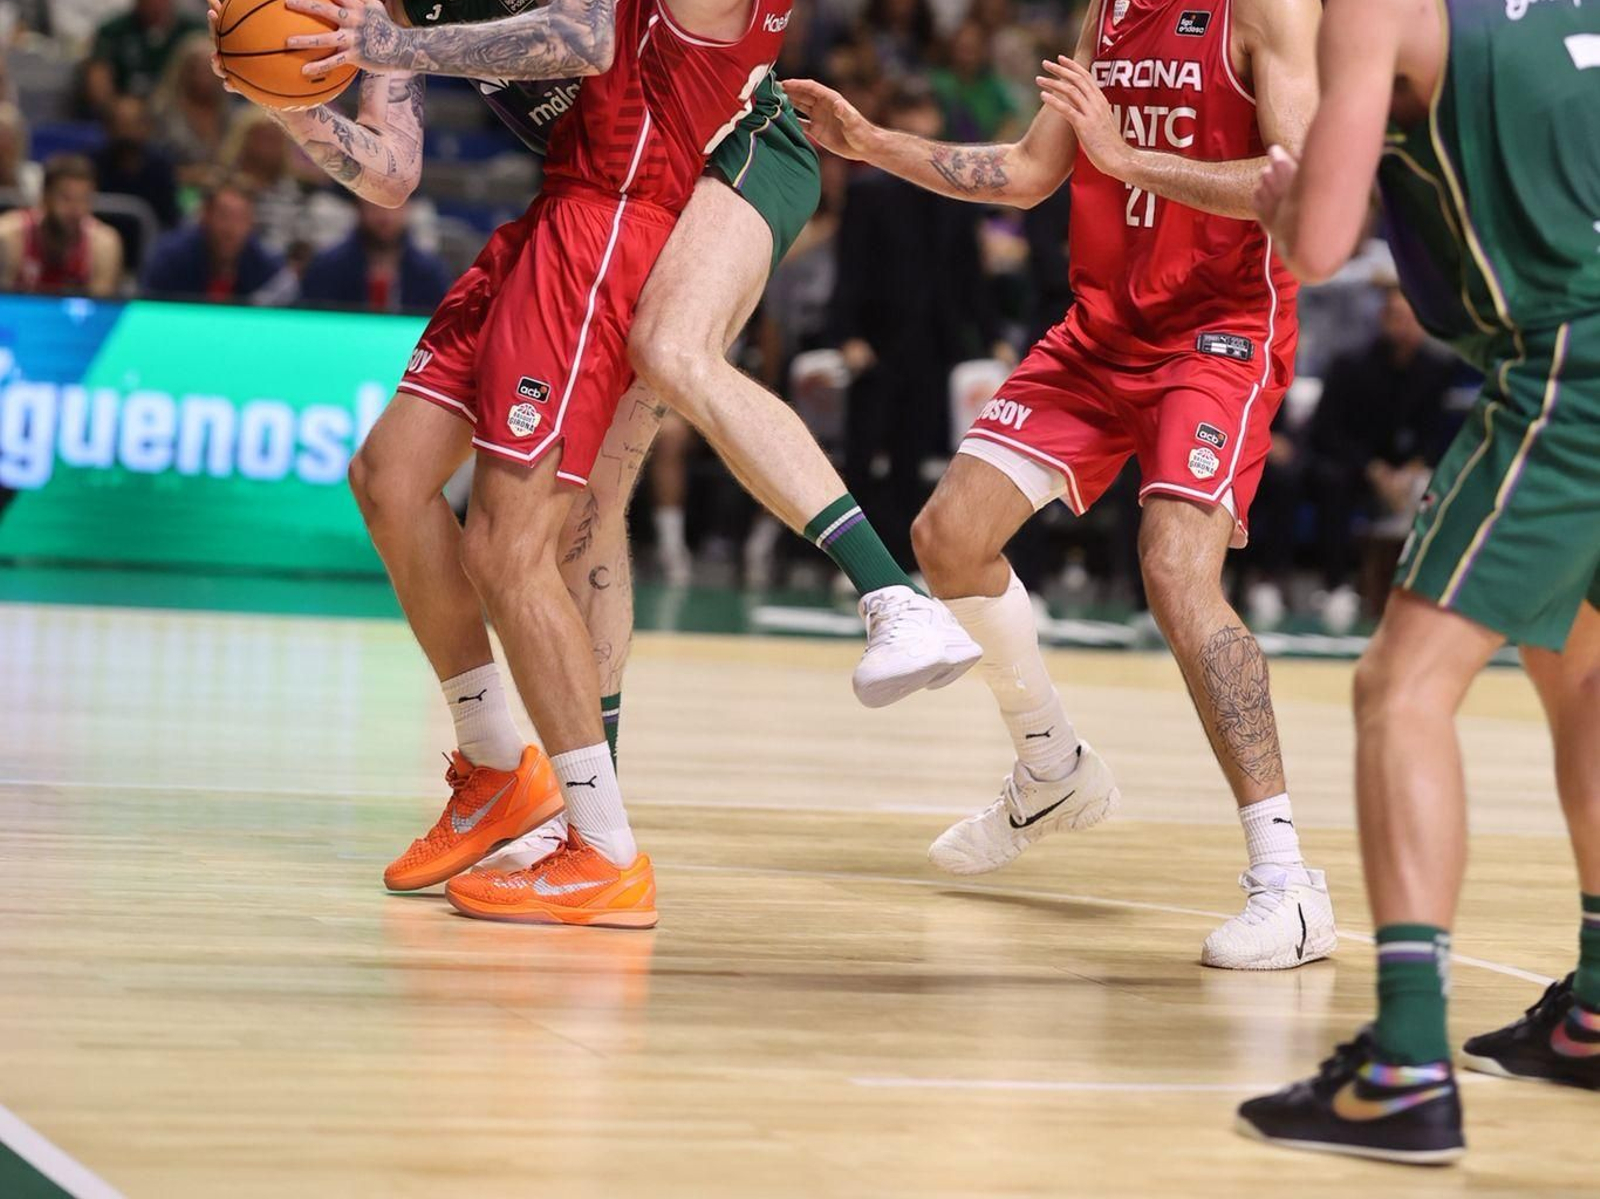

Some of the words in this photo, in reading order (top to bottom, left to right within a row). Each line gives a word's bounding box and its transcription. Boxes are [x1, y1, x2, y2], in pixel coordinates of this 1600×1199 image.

[1124, 182, 1157, 229] 21
[520, 385, 541, 399] acb
[1199, 430, 1219, 444] acb
